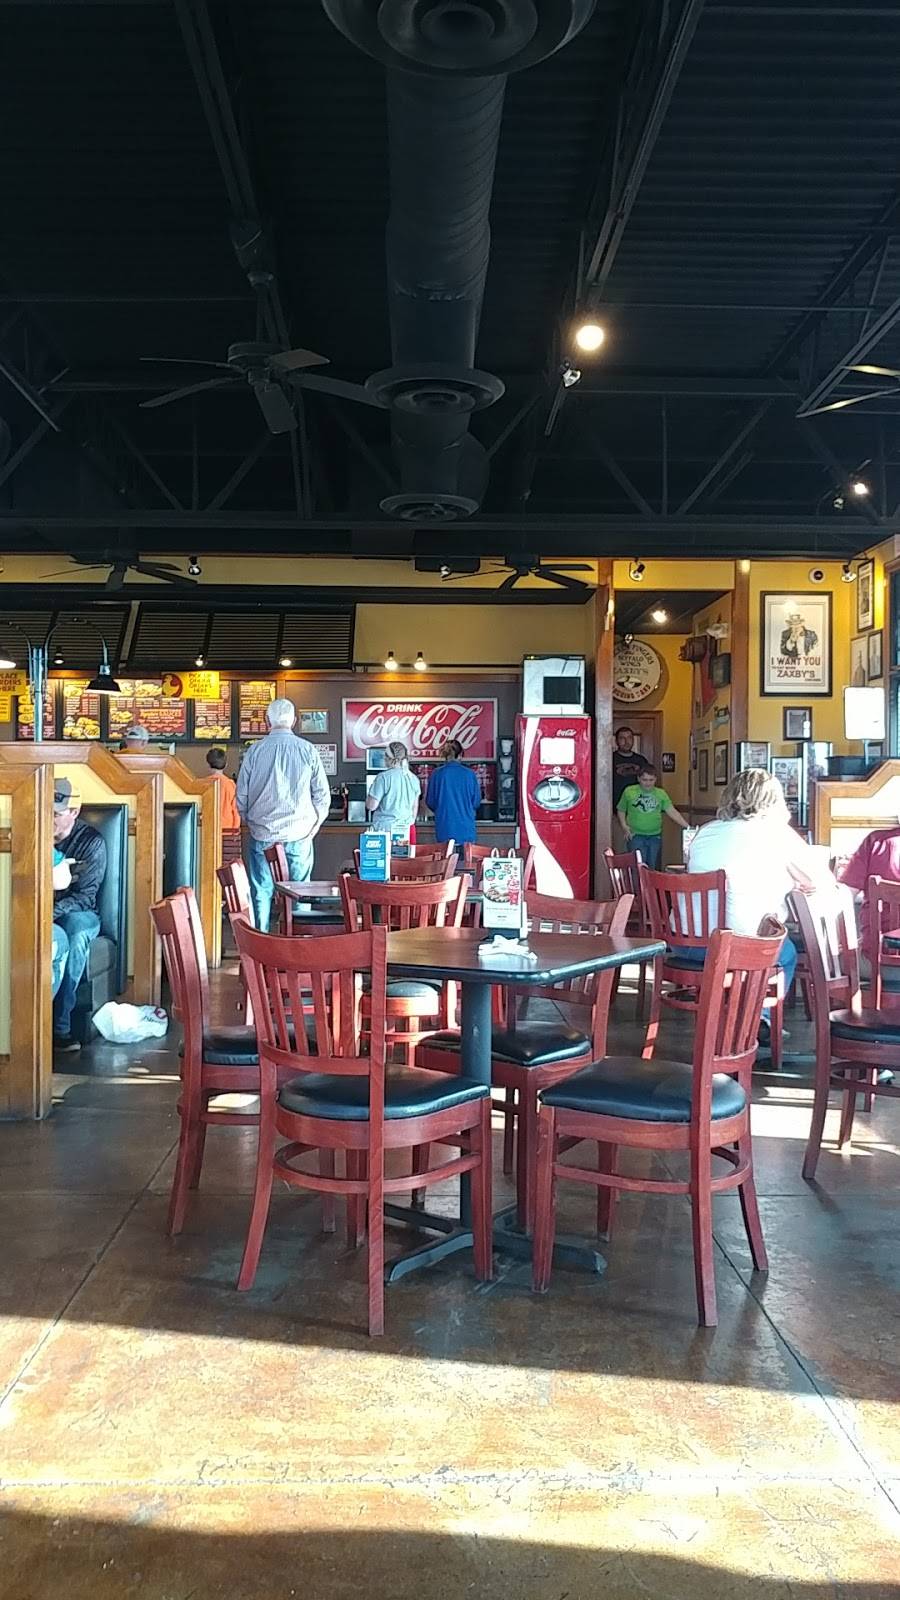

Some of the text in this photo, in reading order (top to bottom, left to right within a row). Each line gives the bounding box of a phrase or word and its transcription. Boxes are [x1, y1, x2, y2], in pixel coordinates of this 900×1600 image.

[776, 656, 802, 665] WANT
[804, 656, 821, 666] YOU
[777, 670, 815, 678] ZAXBY'S
[387, 704, 424, 713] DRINK
[353, 704, 483, 750] Coca-Cola
